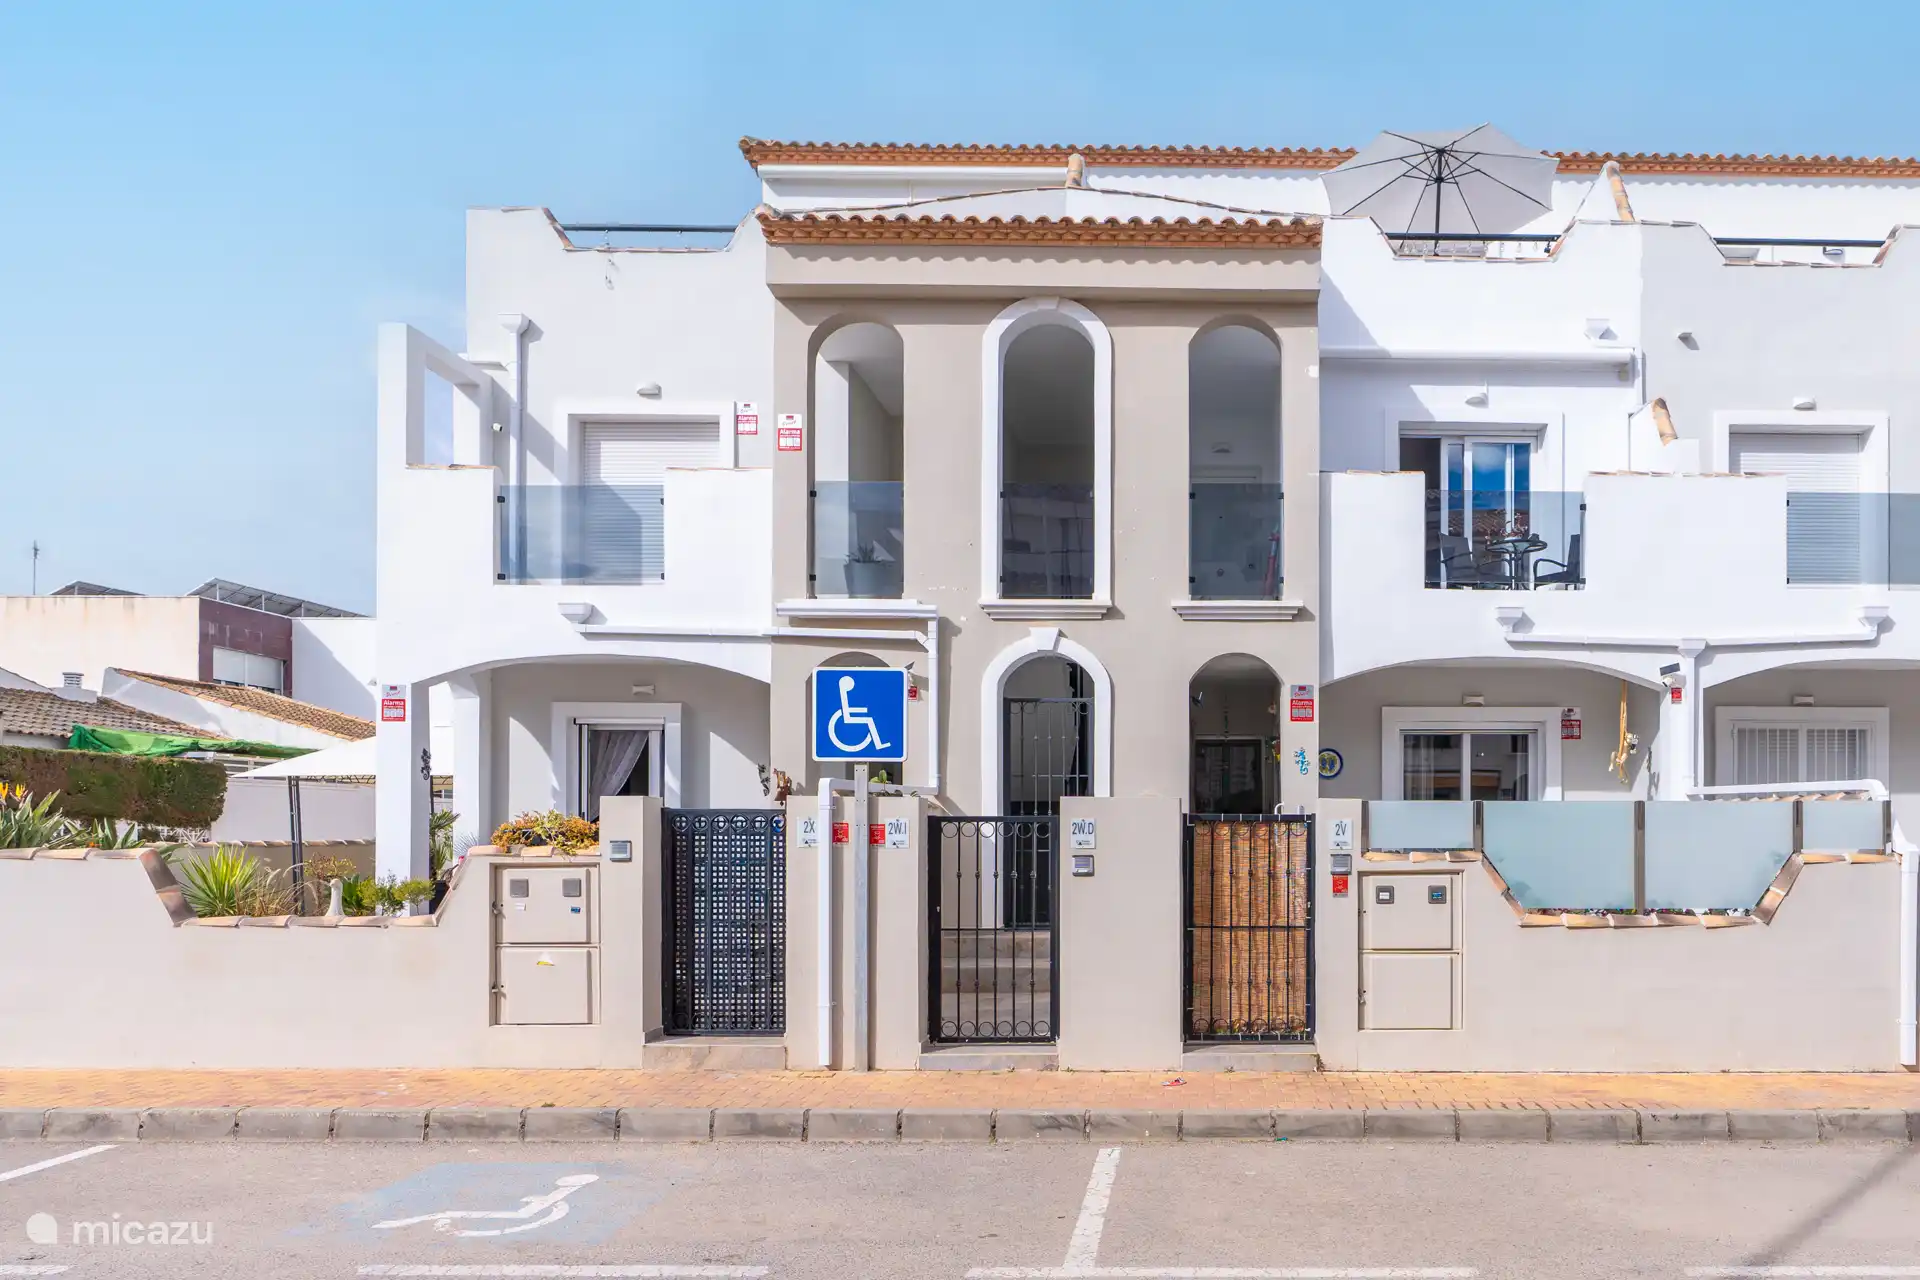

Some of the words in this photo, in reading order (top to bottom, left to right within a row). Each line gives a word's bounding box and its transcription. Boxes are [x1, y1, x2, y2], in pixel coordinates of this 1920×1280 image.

[803, 820, 816, 834] 2X
[888, 821, 907, 835] 2W.I
[1071, 822, 1094, 835] 2W.D
[1335, 823, 1347, 836] 2V
